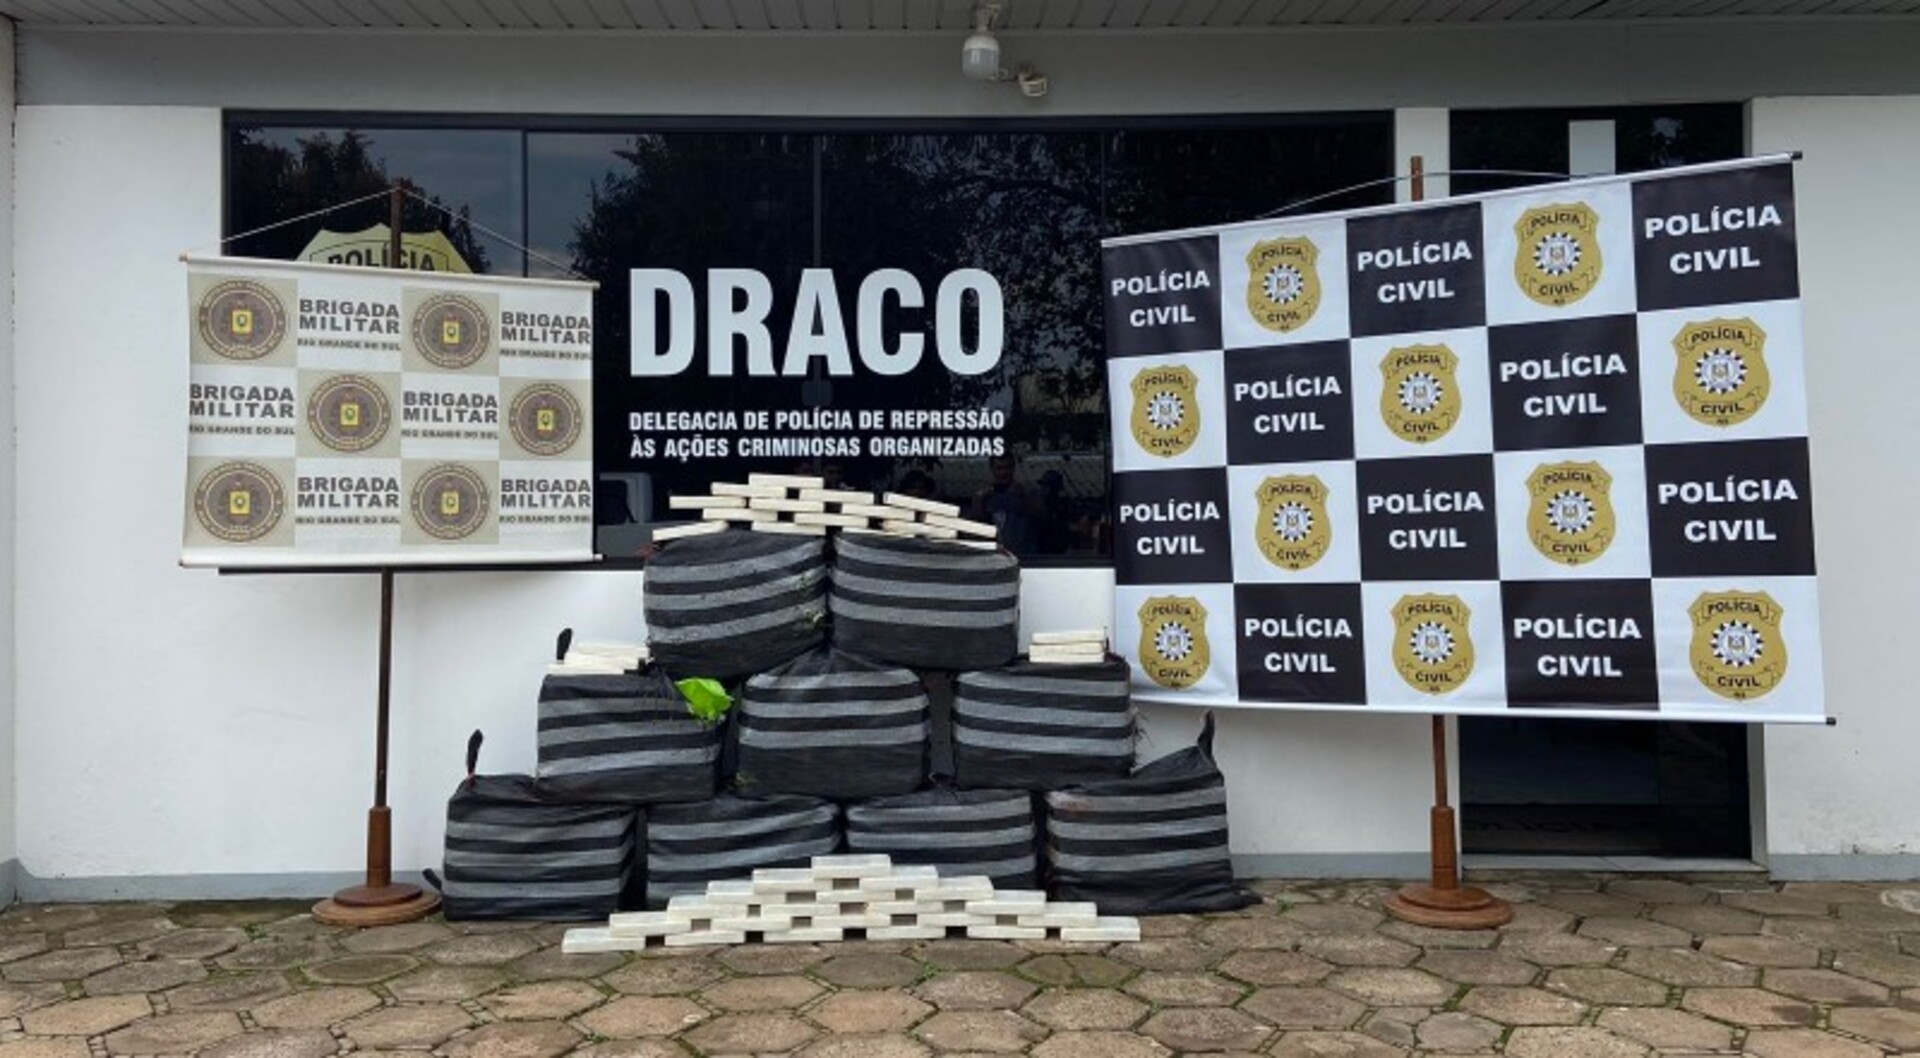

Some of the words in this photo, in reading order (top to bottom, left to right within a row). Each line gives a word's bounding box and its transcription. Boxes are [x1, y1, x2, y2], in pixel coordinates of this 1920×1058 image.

[1645, 205, 1782, 238] POLÍCIA
[1358, 240, 1472, 271] POLÍCIA
[1670, 247, 1760, 273] CIVIL
[1112, 270, 1210, 296] POLÍCIA
[1378, 279, 1454, 303] CIVIL
[1538, 281, 1580, 297] CIVIL
[300, 299, 399, 318] BRIGADA
[1130, 305, 1195, 327] CIVIL
[1266, 310, 1301, 324] CIVIL
[299, 315, 400, 334] MILITAR
[501, 311, 590, 329] BRIGADA
[631, 268, 1004, 376] DRACO
[501, 326, 590, 344] MILITAR
[1500, 353, 1627, 382] POLÍCIA
[190, 383, 294, 401] BRIGADA
[1234, 375, 1341, 401] POLÍCIA
[189, 400, 294, 418] MILITAR
[403, 391, 497, 408] BRIGADA
[1524, 393, 1606, 417] CIVIL
[1700, 401, 1746, 416] CIVIL
[403, 407, 497, 423] MILITAR
[630, 412, 737, 430] DELEGACIA
[744, 412, 768, 429] DE
[776, 408, 852, 429] POLÍCIA
[860, 411, 883, 429] DE
[891, 408, 1004, 429] REPRESSÃO
[1254, 412, 1324, 433] CIVIL
[1402, 420, 1440, 434] CIVIL
[631, 435, 655, 457] ÀS
[665, 434, 728, 461] AÇÕES
[739, 437, 860, 456] CRIMINOSAS
[870, 437, 1004, 456] ORGANIZADAS
[1150, 435, 1184, 449] CIVIL
[298, 477, 399, 492] BRIGADA
[501, 479, 591, 492] BRIGADA
[1658, 476, 1798, 504] POLÍCIA
[298, 494, 399, 507] MILITAR
[501, 494, 591, 507] MILITAR
[1367, 488, 1484, 514] POLÍCIA
[1120, 499, 1220, 522] POLÍCIA
[1389, 528, 1466, 549] CIVIL
[1685, 519, 1776, 542] CIVIL
[1137, 536, 1205, 555] CIVIL
[1551, 542, 1592, 554] CIVIL
[1245, 614, 1352, 638] POLÍCIA
[1514, 614, 1641, 638] POLÍCIA
[1265, 653, 1336, 672] CIVIL
[1538, 655, 1622, 676] CIVIL
[1414, 670, 1453, 684] CIVIL
[1716, 675, 1761, 688] CIVIL
